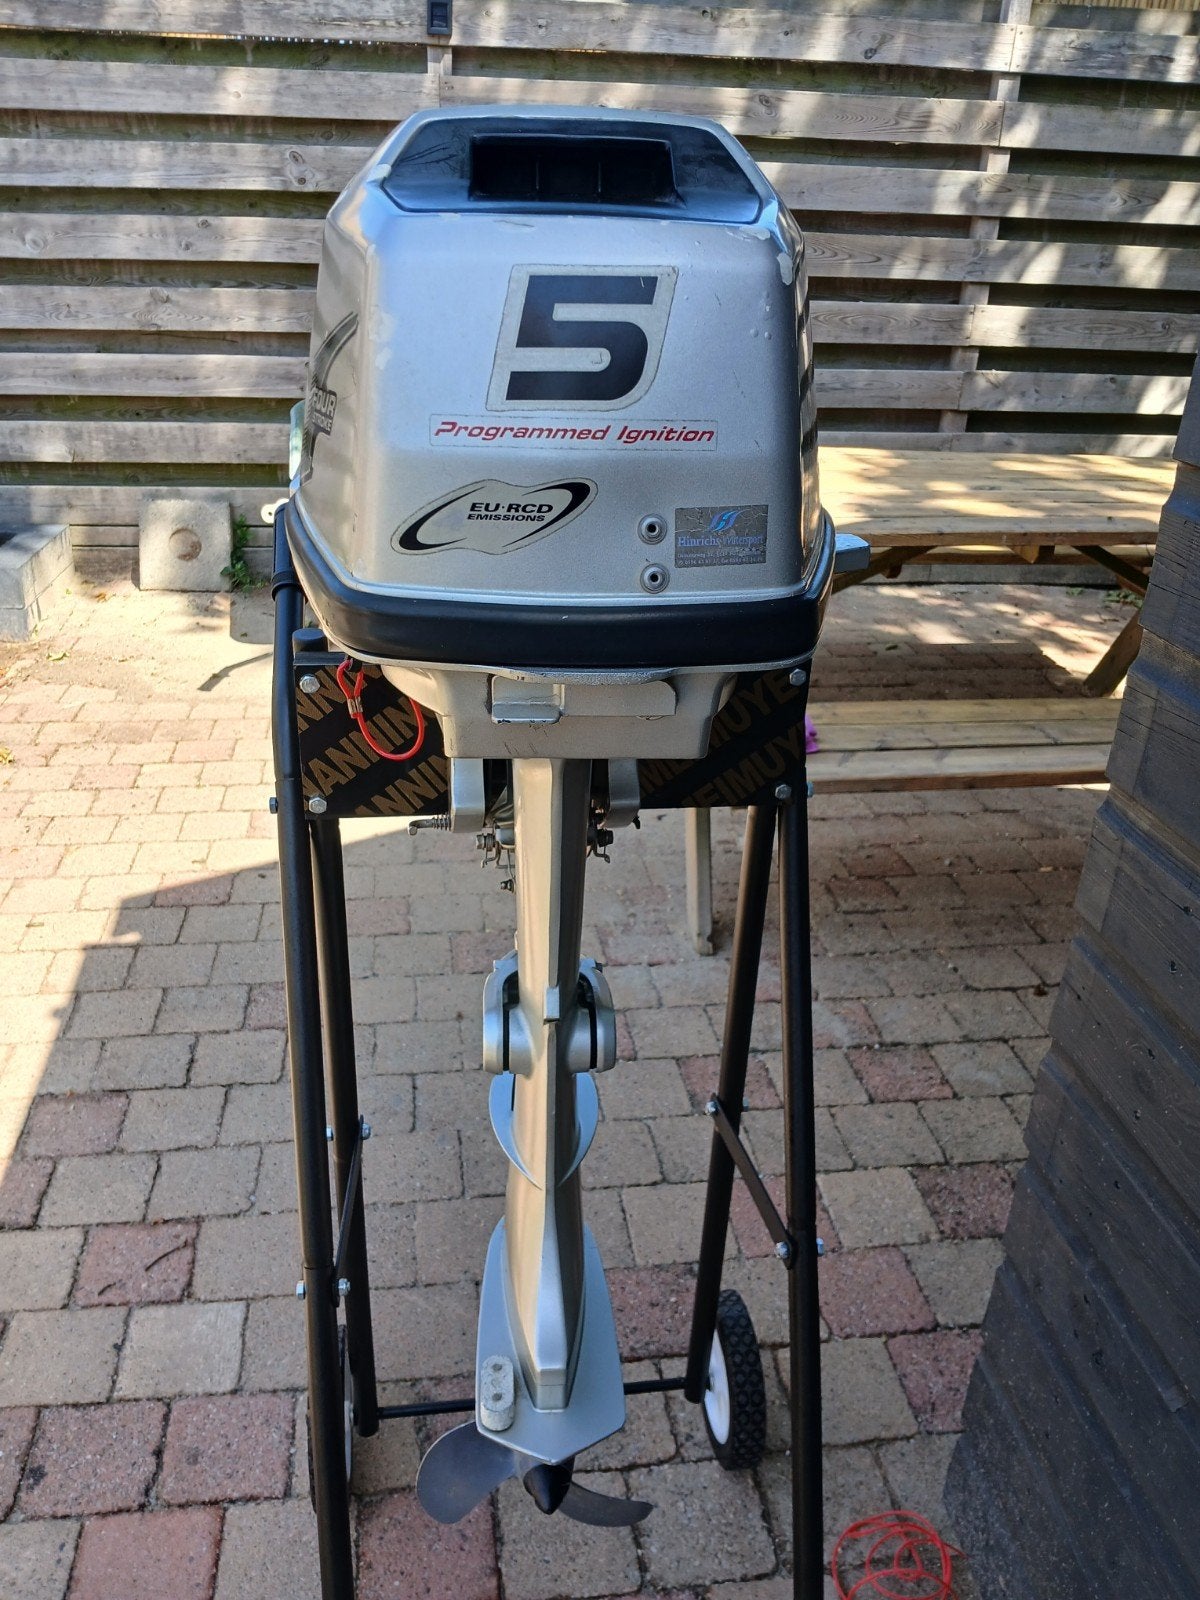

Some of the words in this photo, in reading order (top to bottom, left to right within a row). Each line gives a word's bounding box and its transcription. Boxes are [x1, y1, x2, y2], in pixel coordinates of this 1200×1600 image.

[506, 275, 658, 401] 5
[434, 421, 611, 441] Programmed
[617, 425, 715, 444] Ignition
[467, 513, 546, 522] EMISSIONS
[678, 535, 720, 547] Hinrichs
